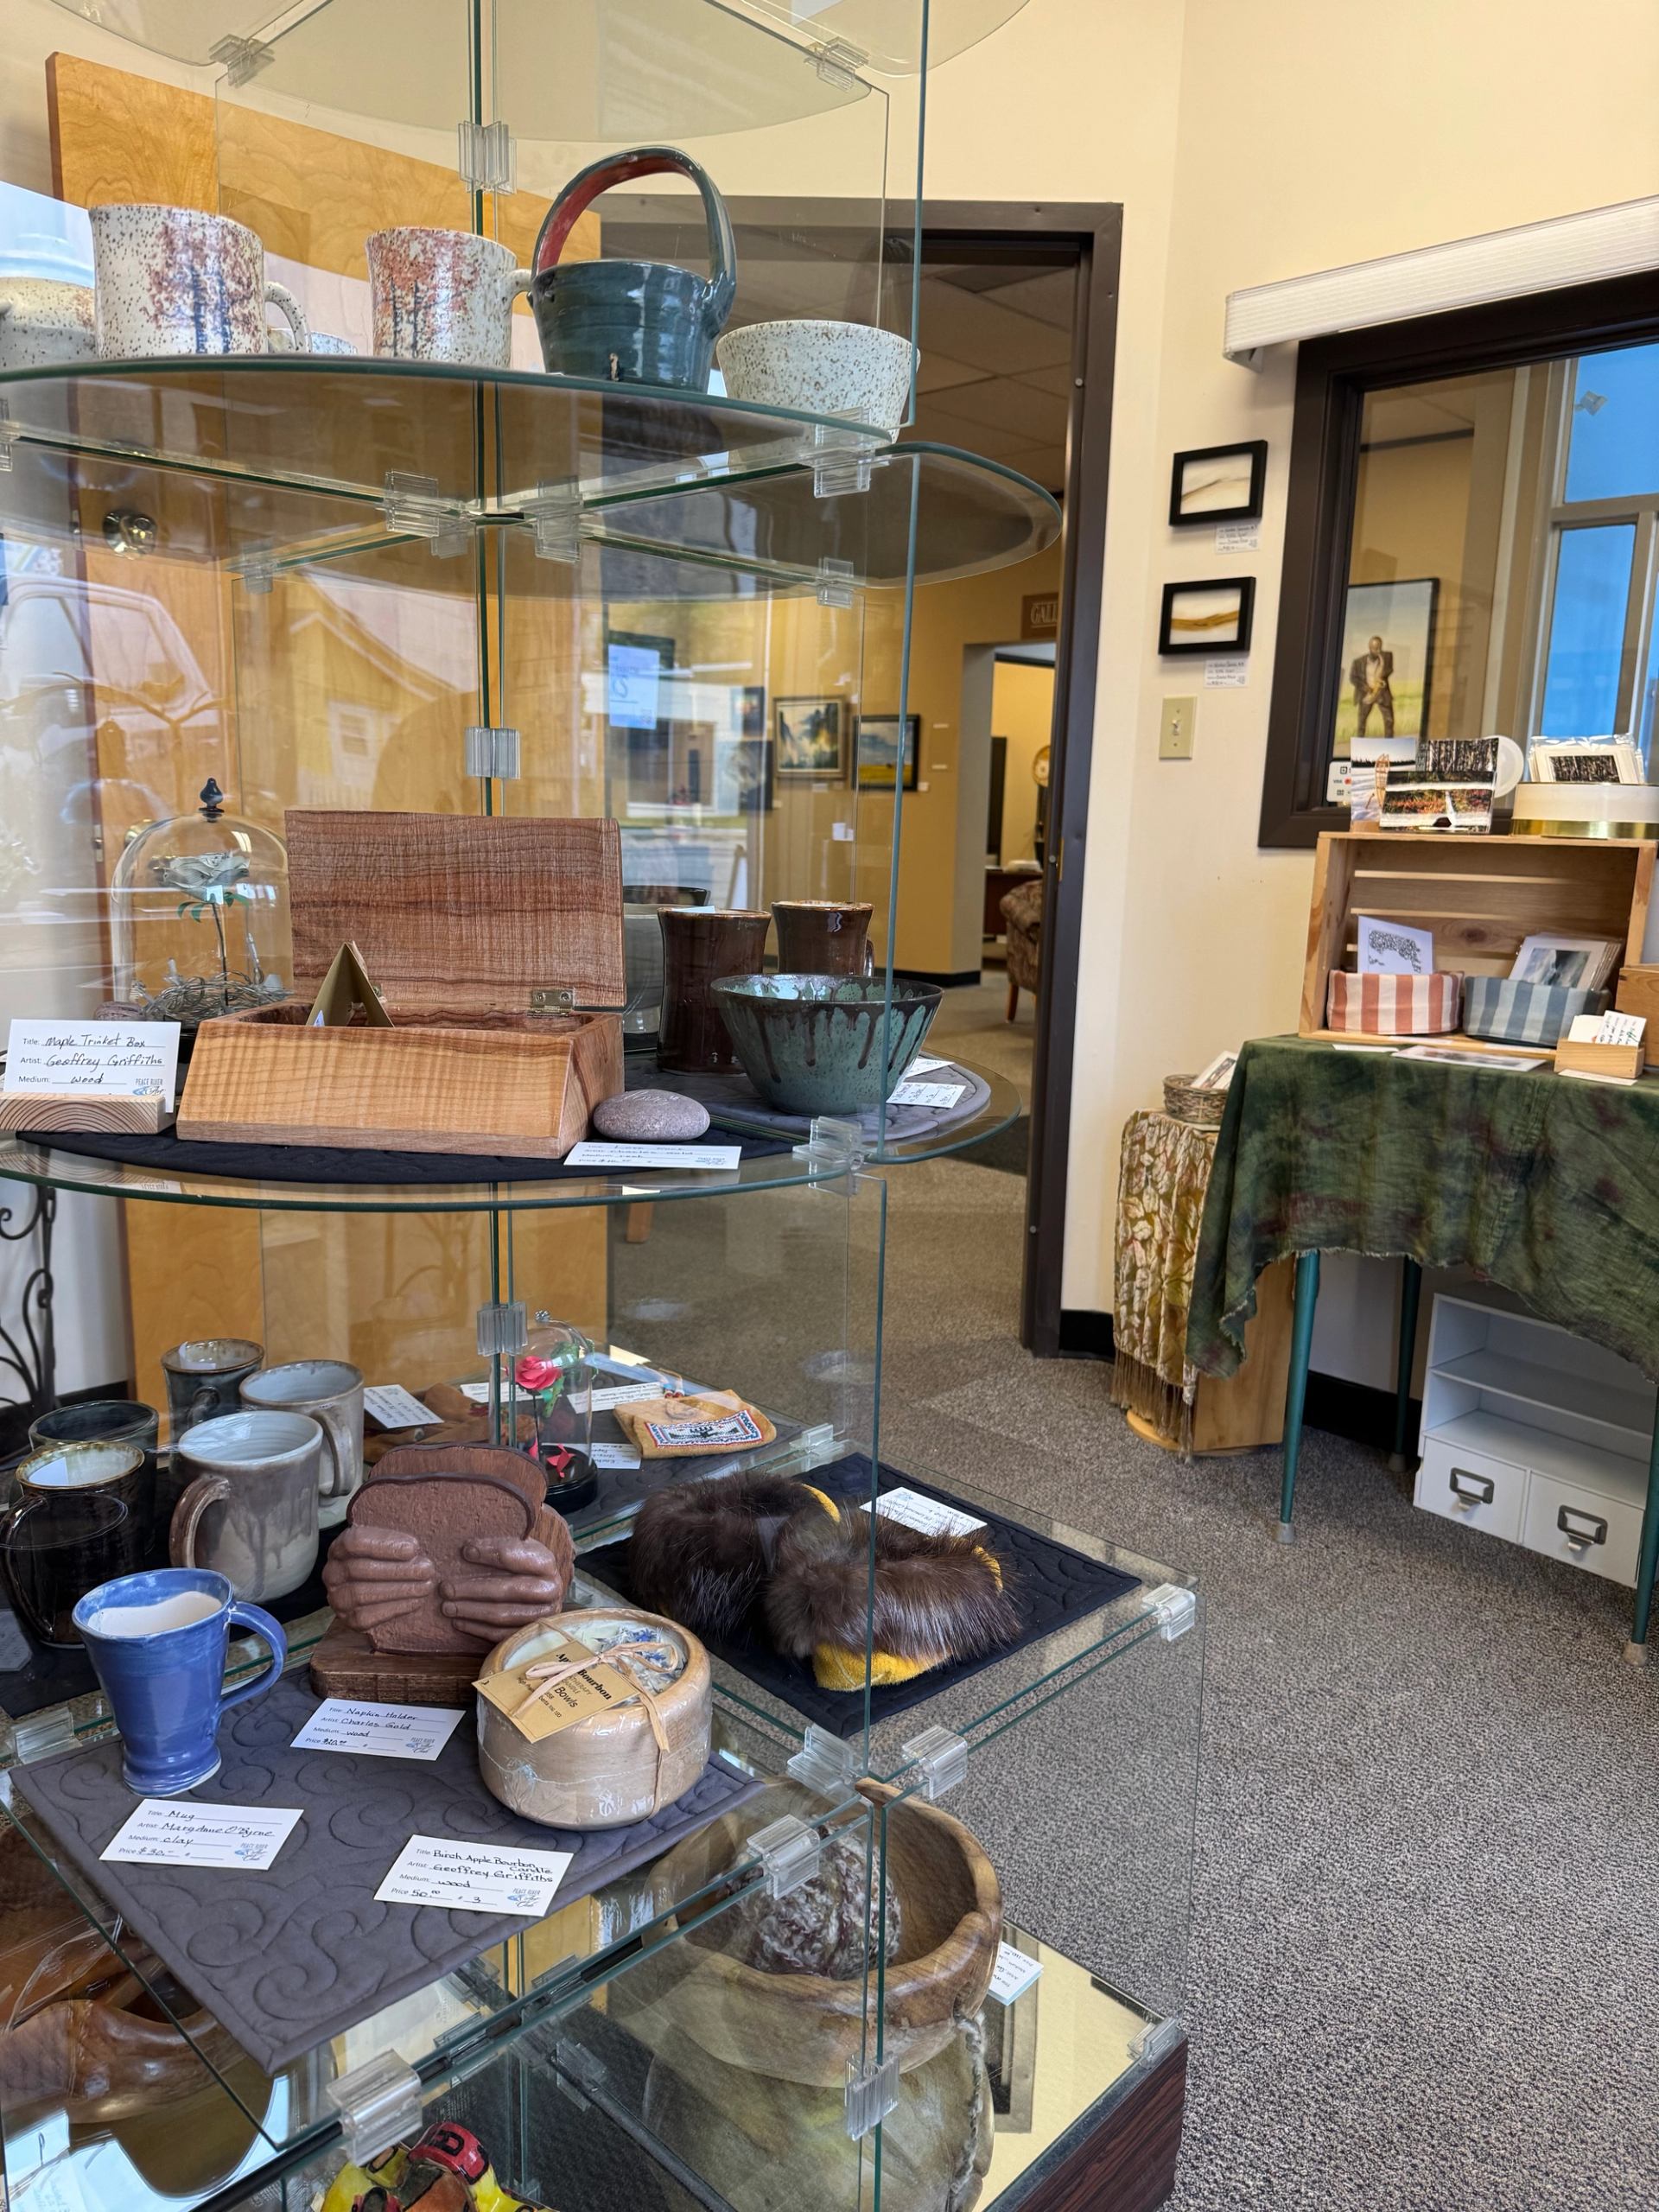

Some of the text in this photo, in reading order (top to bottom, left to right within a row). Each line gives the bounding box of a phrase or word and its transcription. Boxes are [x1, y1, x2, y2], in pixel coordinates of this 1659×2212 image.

[1030, 602, 1057, 624] GALL
[80, 1033, 122, 1046] Trinket
[126, 1037, 145, 1048] Box
[46, 1052, 99, 1073] Geoffrey
[106, 1054, 162, 1066] Griffiths
[70, 1073, 104, 1084] wood
[135, 1077, 149, 1086] PEACE
[577, 1669, 612, 1700] Bourbon
[554, 1686, 578, 1707] Bowls
[346, 1707, 379, 1719] Napkin
[385, 1711, 418, 1720] Holder
[340, 1717, 380, 1727] Charles
[385, 1720, 411, 1731] Gold
[167, 1810, 194, 1821] Mug
[162, 1835, 194, 1847] clay
[433, 1849, 462, 1860] Birch
[467, 1853, 493, 1865] Apple
[494, 1855, 536, 1868] Bourbon
[432, 1864, 489, 1878] Geoffrey
[493, 1870, 554, 1883] Griffiths
